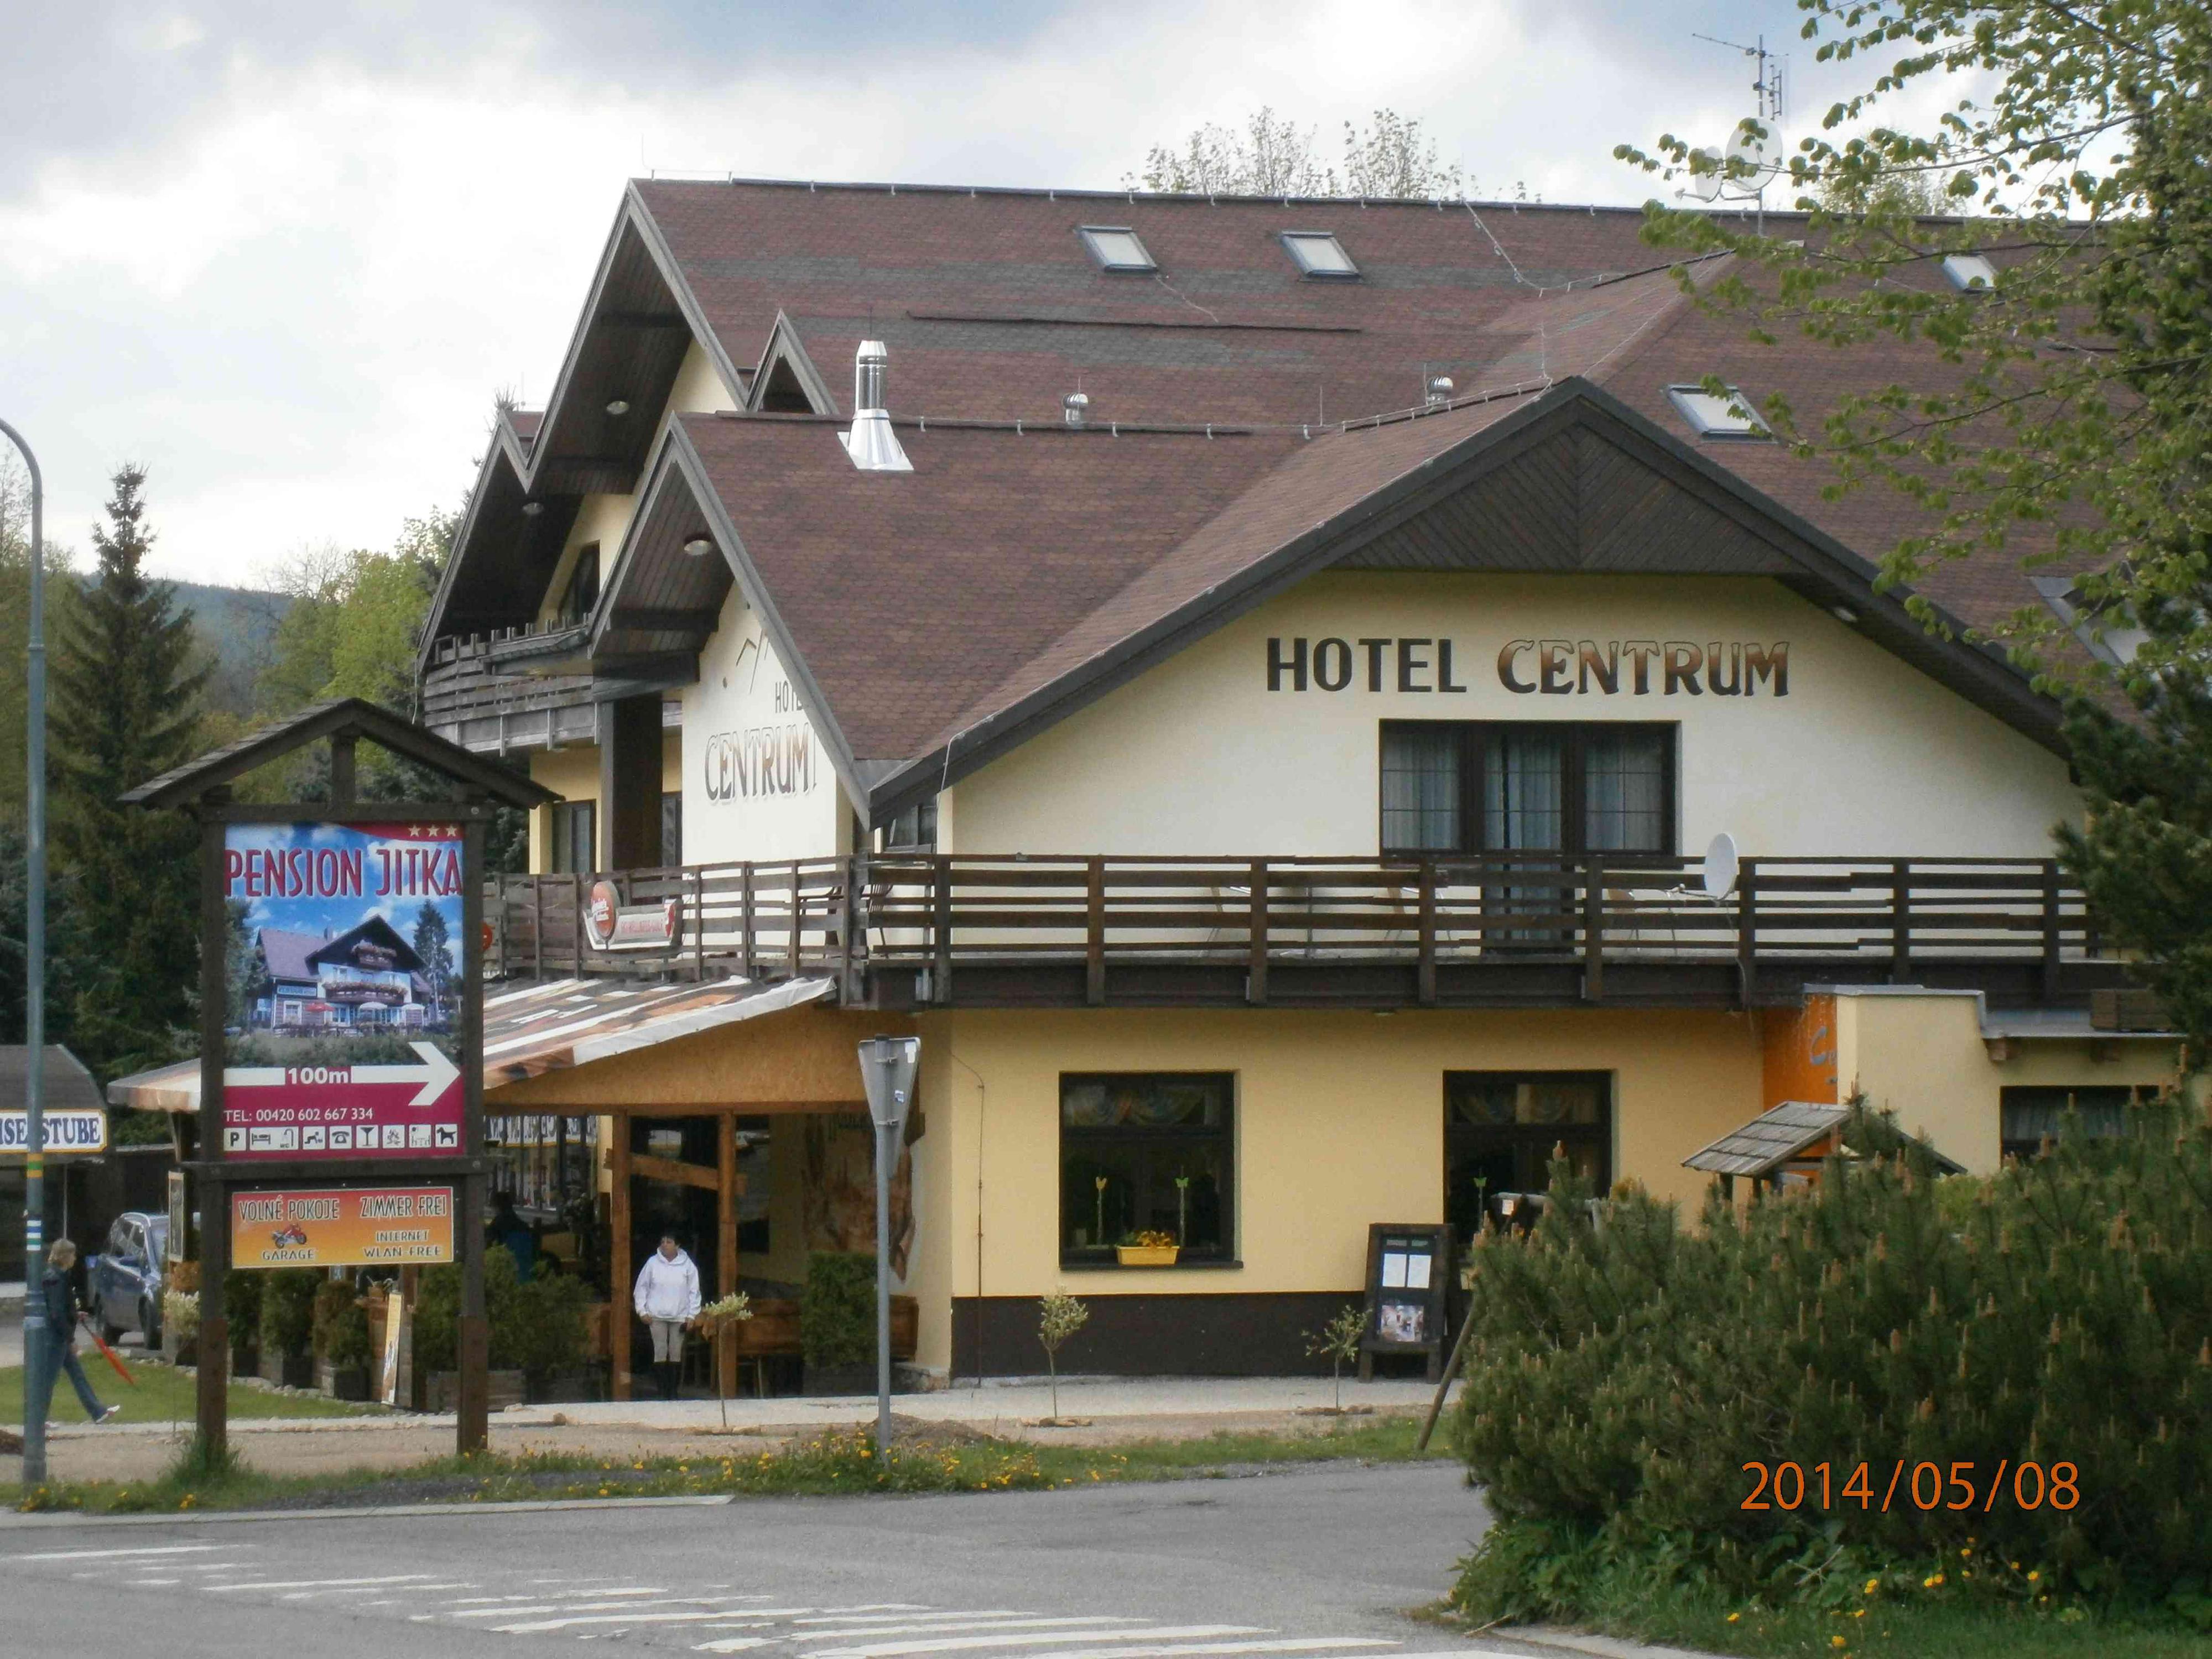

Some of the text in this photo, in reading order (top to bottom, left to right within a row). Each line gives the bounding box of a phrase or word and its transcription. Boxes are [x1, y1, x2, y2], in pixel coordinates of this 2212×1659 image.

[1267, 637, 1791, 697] HOTEL CENTRUM
[705, 722, 809, 801] CENTRUM
[224, 848, 463, 897] PENSION JITKA
[288, 1067, 349, 1085] 100m
[223, 1107, 373, 1122] TEL: 00420 602 667 334
[238, 1194, 340, 1222] VOLNÉ POKOJE
[361, 1194, 447, 1218] ZIMMER FREI
[376, 1230, 429, 1243] INTERNET
[262, 1249, 315, 1261] GARAGE
